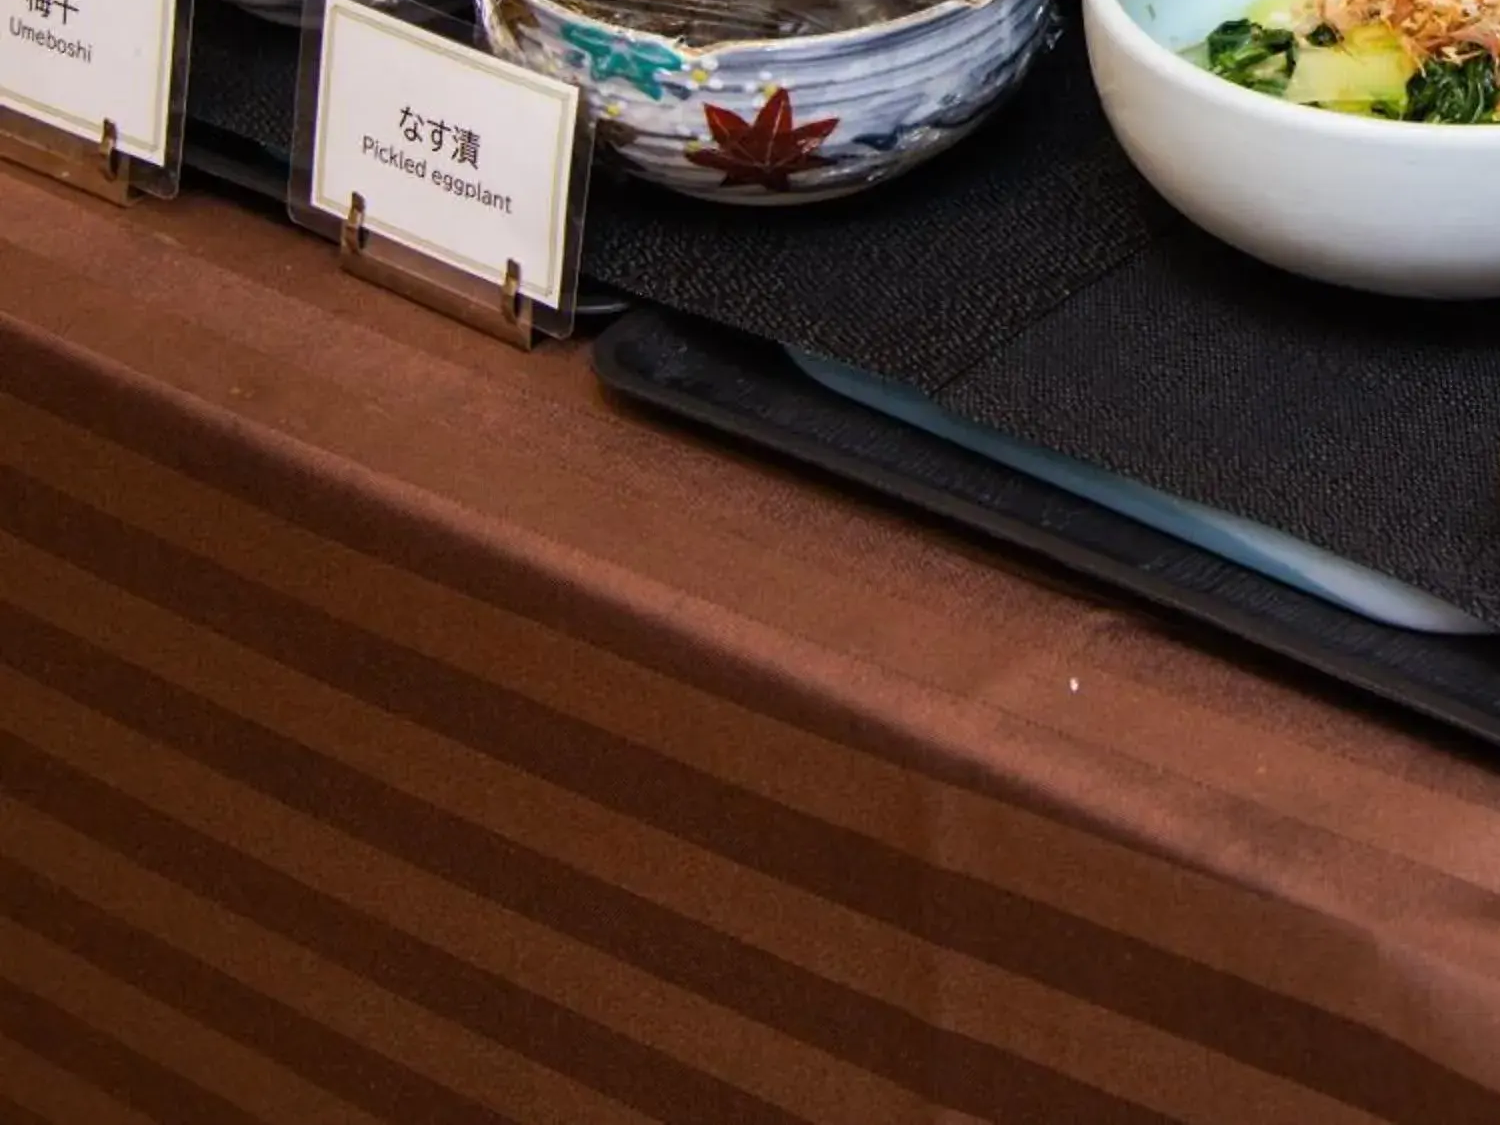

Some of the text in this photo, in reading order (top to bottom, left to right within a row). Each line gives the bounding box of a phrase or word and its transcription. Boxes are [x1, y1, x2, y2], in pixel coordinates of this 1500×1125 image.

[9, 15, 93, 64] Umeboshi
[399, 105, 482, 170] なす漬
[362, 134, 513, 215] Pickled eggplant
